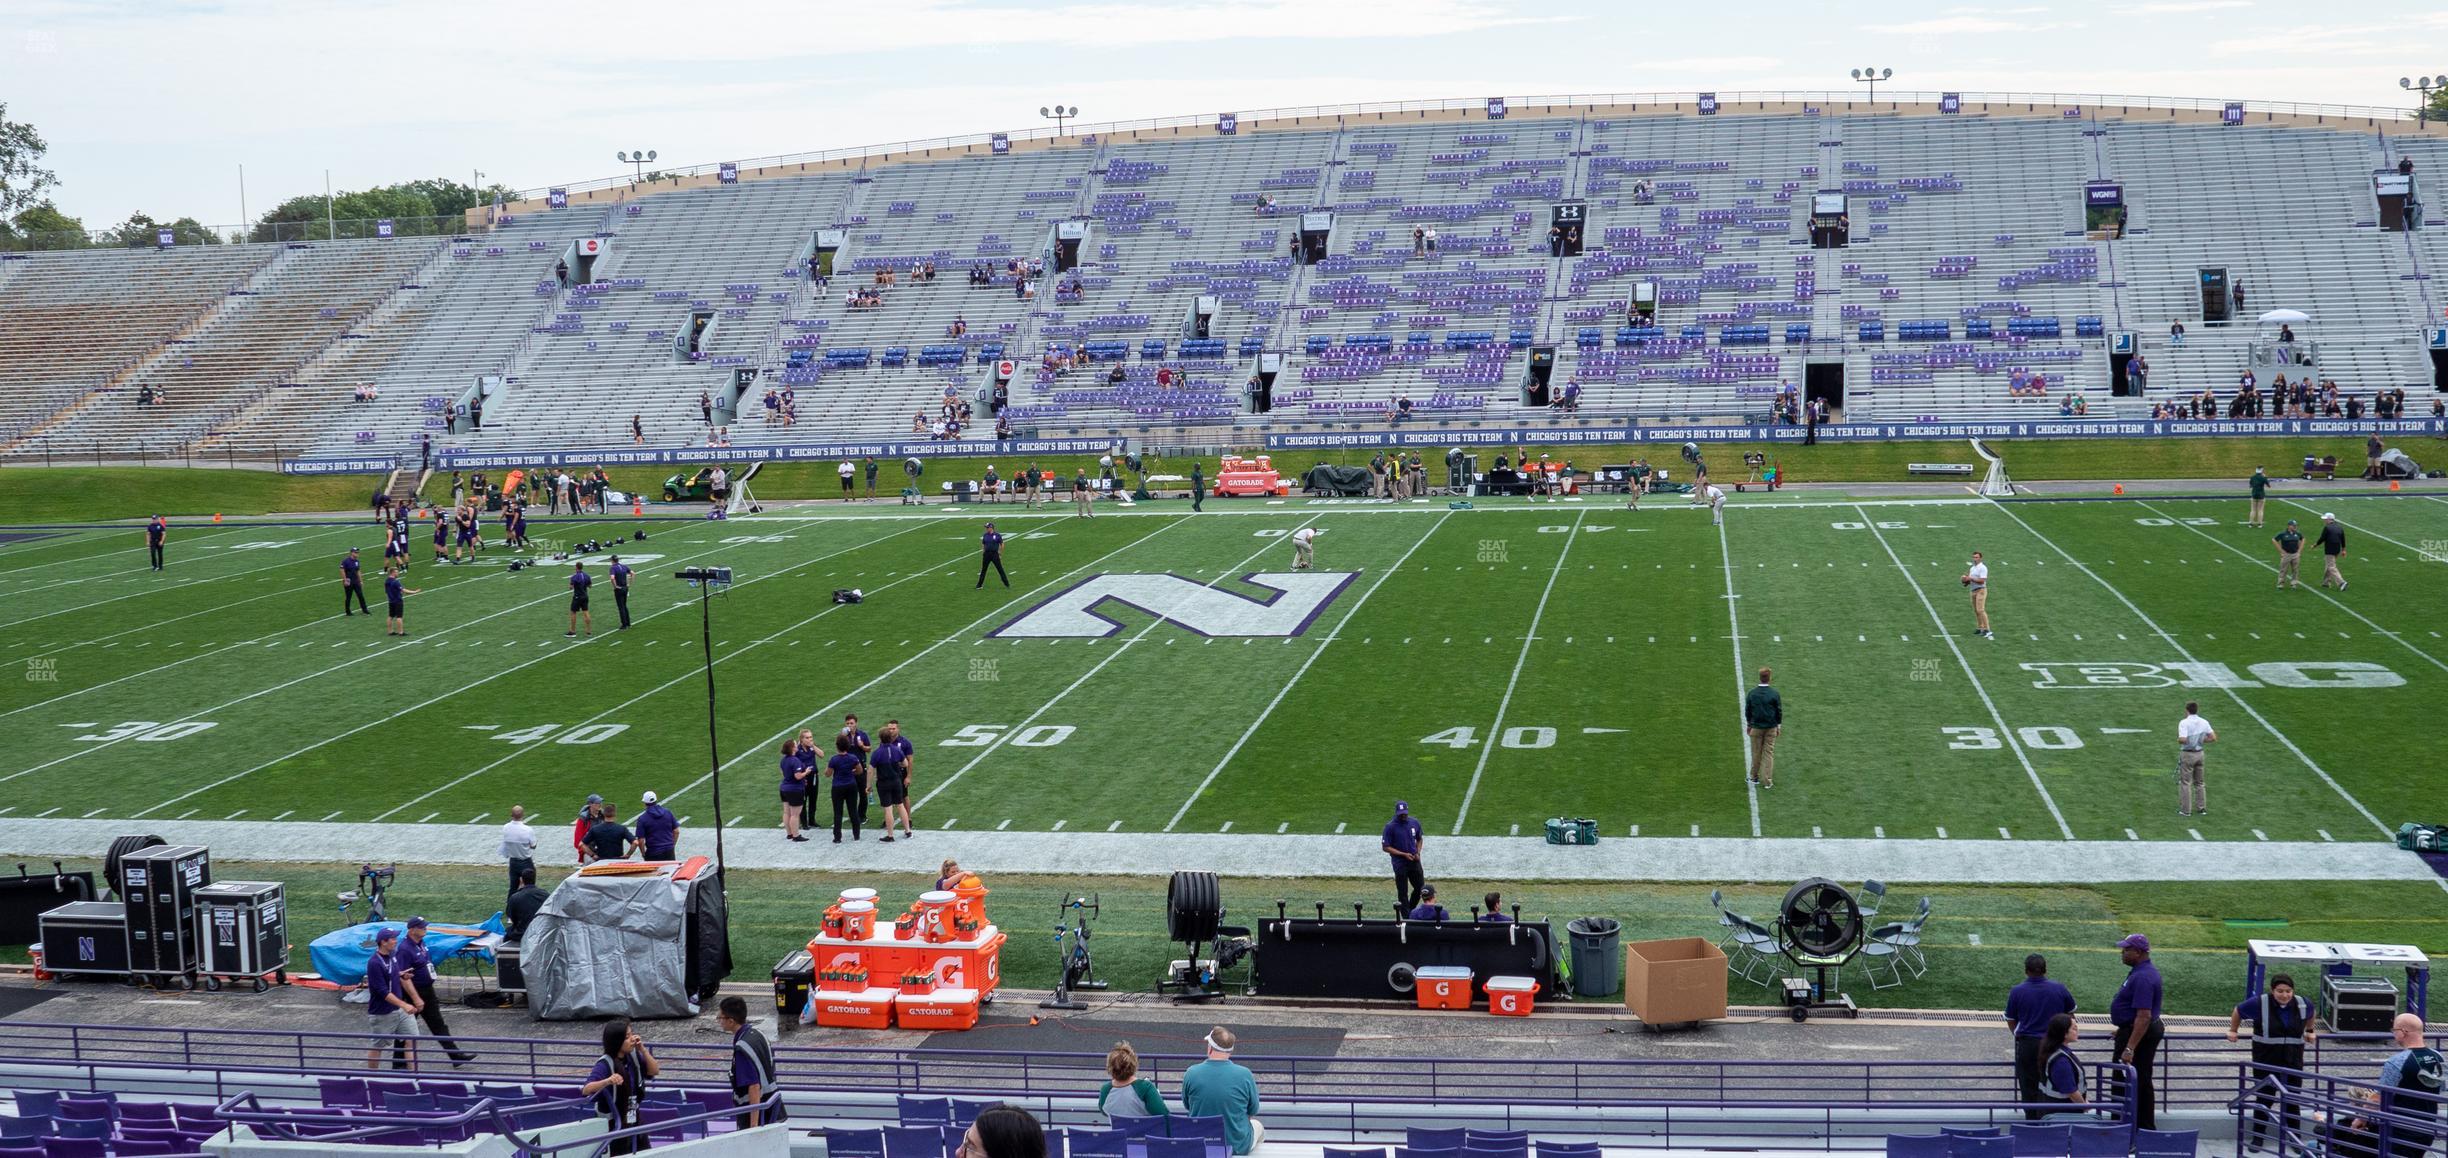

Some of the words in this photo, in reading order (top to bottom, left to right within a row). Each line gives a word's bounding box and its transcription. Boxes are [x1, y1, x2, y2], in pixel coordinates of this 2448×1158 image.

[1489, 104, 1503, 114] 108
[1700, 99, 1714, 109] 109
[1944, 99, 1957, 110] 110
[2228, 109, 2240, 119] 111
[1221, 119, 1235, 130] 107
[993, 139, 1007, 150] 106
[721, 169, 736, 179] 105
[551, 194, 566, 205] 104
[378, 225, 392, 235] 103
[1062, 228, 1082, 236] Hilton
[160, 233, 174, 244] 102
[1904, 427, 1949, 436] CHICAGO'S
[1950, 426, 1965, 435] BIG
[1966, 426, 1984, 435] TEN
[1986, 426, 2010, 435] TEAM
[2036, 425, 2081, 434] CHICAGO'S
[2083, 425, 2098, 434] BIG
[2100, 425, 2118, 434] TEN
[2120, 425, 2144, 434] TEAM
[2170, 424, 2218, 433] CHICAGO'S
[2219, 423, 2235, 433] BIG
[2237, 424, 2256, 432] TEN
[2258, 423, 2283, 432] TEAM
[2310, 422, 2358, 432] CHICAGO'S
[2360, 422, 2375, 431] BIG
[2377, 422, 2396, 431] TEN
[2399, 422, 2425, 431] TEAM
[1404, 434, 1446, 443] CHICAGO'S
[1447, 434, 1460, 443] BIG
[1462, 434, 1478, 442] TEN
[1480, 433, 1503, 442] TEAM
[1526, 432, 1568, 441] CHICAGO'S
[1569, 432, 1583, 441] BIG
[1585, 432, 1601, 441] TEN
[1603, 431, 1626, 440] TEAM
[1649, 430, 1692, 440] CHICAGO'S
[1693, 430, 1708, 439] BIG
[1710, 430, 1726, 439] TEN
[1728, 430, 1751, 439] TEAM
[1775, 429, 1819, 438] CHICAGS
[1820, 428, 1834, 437] BIG
[1836, 428, 1854, 437] TEN
[1856, 428, 1879, 437] TEAM
[1285, 436, 1326, 446] CHICAGO'S
[1327, 436, 1341, 445] BIG
[1360, 435, 1381, 444] TEAM
[790, 448, 829, 457] CHICAGO'S
[830, 447, 842, 456] BIG
[844, 447, 861, 456] TEN
[862, 447, 882, 455] TEAM
[903, 445, 943, 454] CHICAGO'S
[944, 445, 957, 454] BIG
[958, 444, 974, 453] TEN
[975, 444, 996, 453] TEAM
[1017, 442, 1057, 452] CHICAGO'S
[1058, 442, 1071, 451] BIG
[1073, 442, 1088, 451] TEN
[1090, 441, 1110, 450] TEAM
[565, 454, 604, 464] CHICAGO'S
[605, 454, 618, 462] BIG
[620, 454, 635, 462] TEN
[637, 453, 657, 462] TEAM
[677, 451, 715, 460] CHICAGO'S
[717, 451, 730, 459] BIG
[731, 451, 747, 459] TEN
[749, 450, 769, 459] TEAM
[294, 463, 333, 472] CHICAGO'S
[334, 462, 348, 471] BIG
[349, 462, 366, 470] TEN
[366, 461, 386, 470] TEAM
[453, 458, 492, 467] CHICAGO'S
[493, 457, 506, 466] BIG
[508, 457, 523, 465] TEN
[525, 456, 545, 465] TEAM
[1227, 479, 1264, 487] GATORADE
[397, 523, 406, 534] 17
[984, 571, 1362, 638] N
[75, 721, 218, 742] 30
[490, 723, 631, 745] 40
[939, 725, 1077, 747] 50
[1420, 726, 1558, 749] 40
[1941, 726, 2084, 750] 30
[926, 909, 939, 924] G
[850, 918, 859, 928] G
[78, 936, 96, 961] N
[933, 956, 965, 988] G
[987, 956, 997, 980] G
[1435, 981, 1449, 996] G
[1500, 994, 1516, 1012] G
[827, 1005, 871, 1015] GATORADE
[908, 1007, 954, 1017] GATORADE
